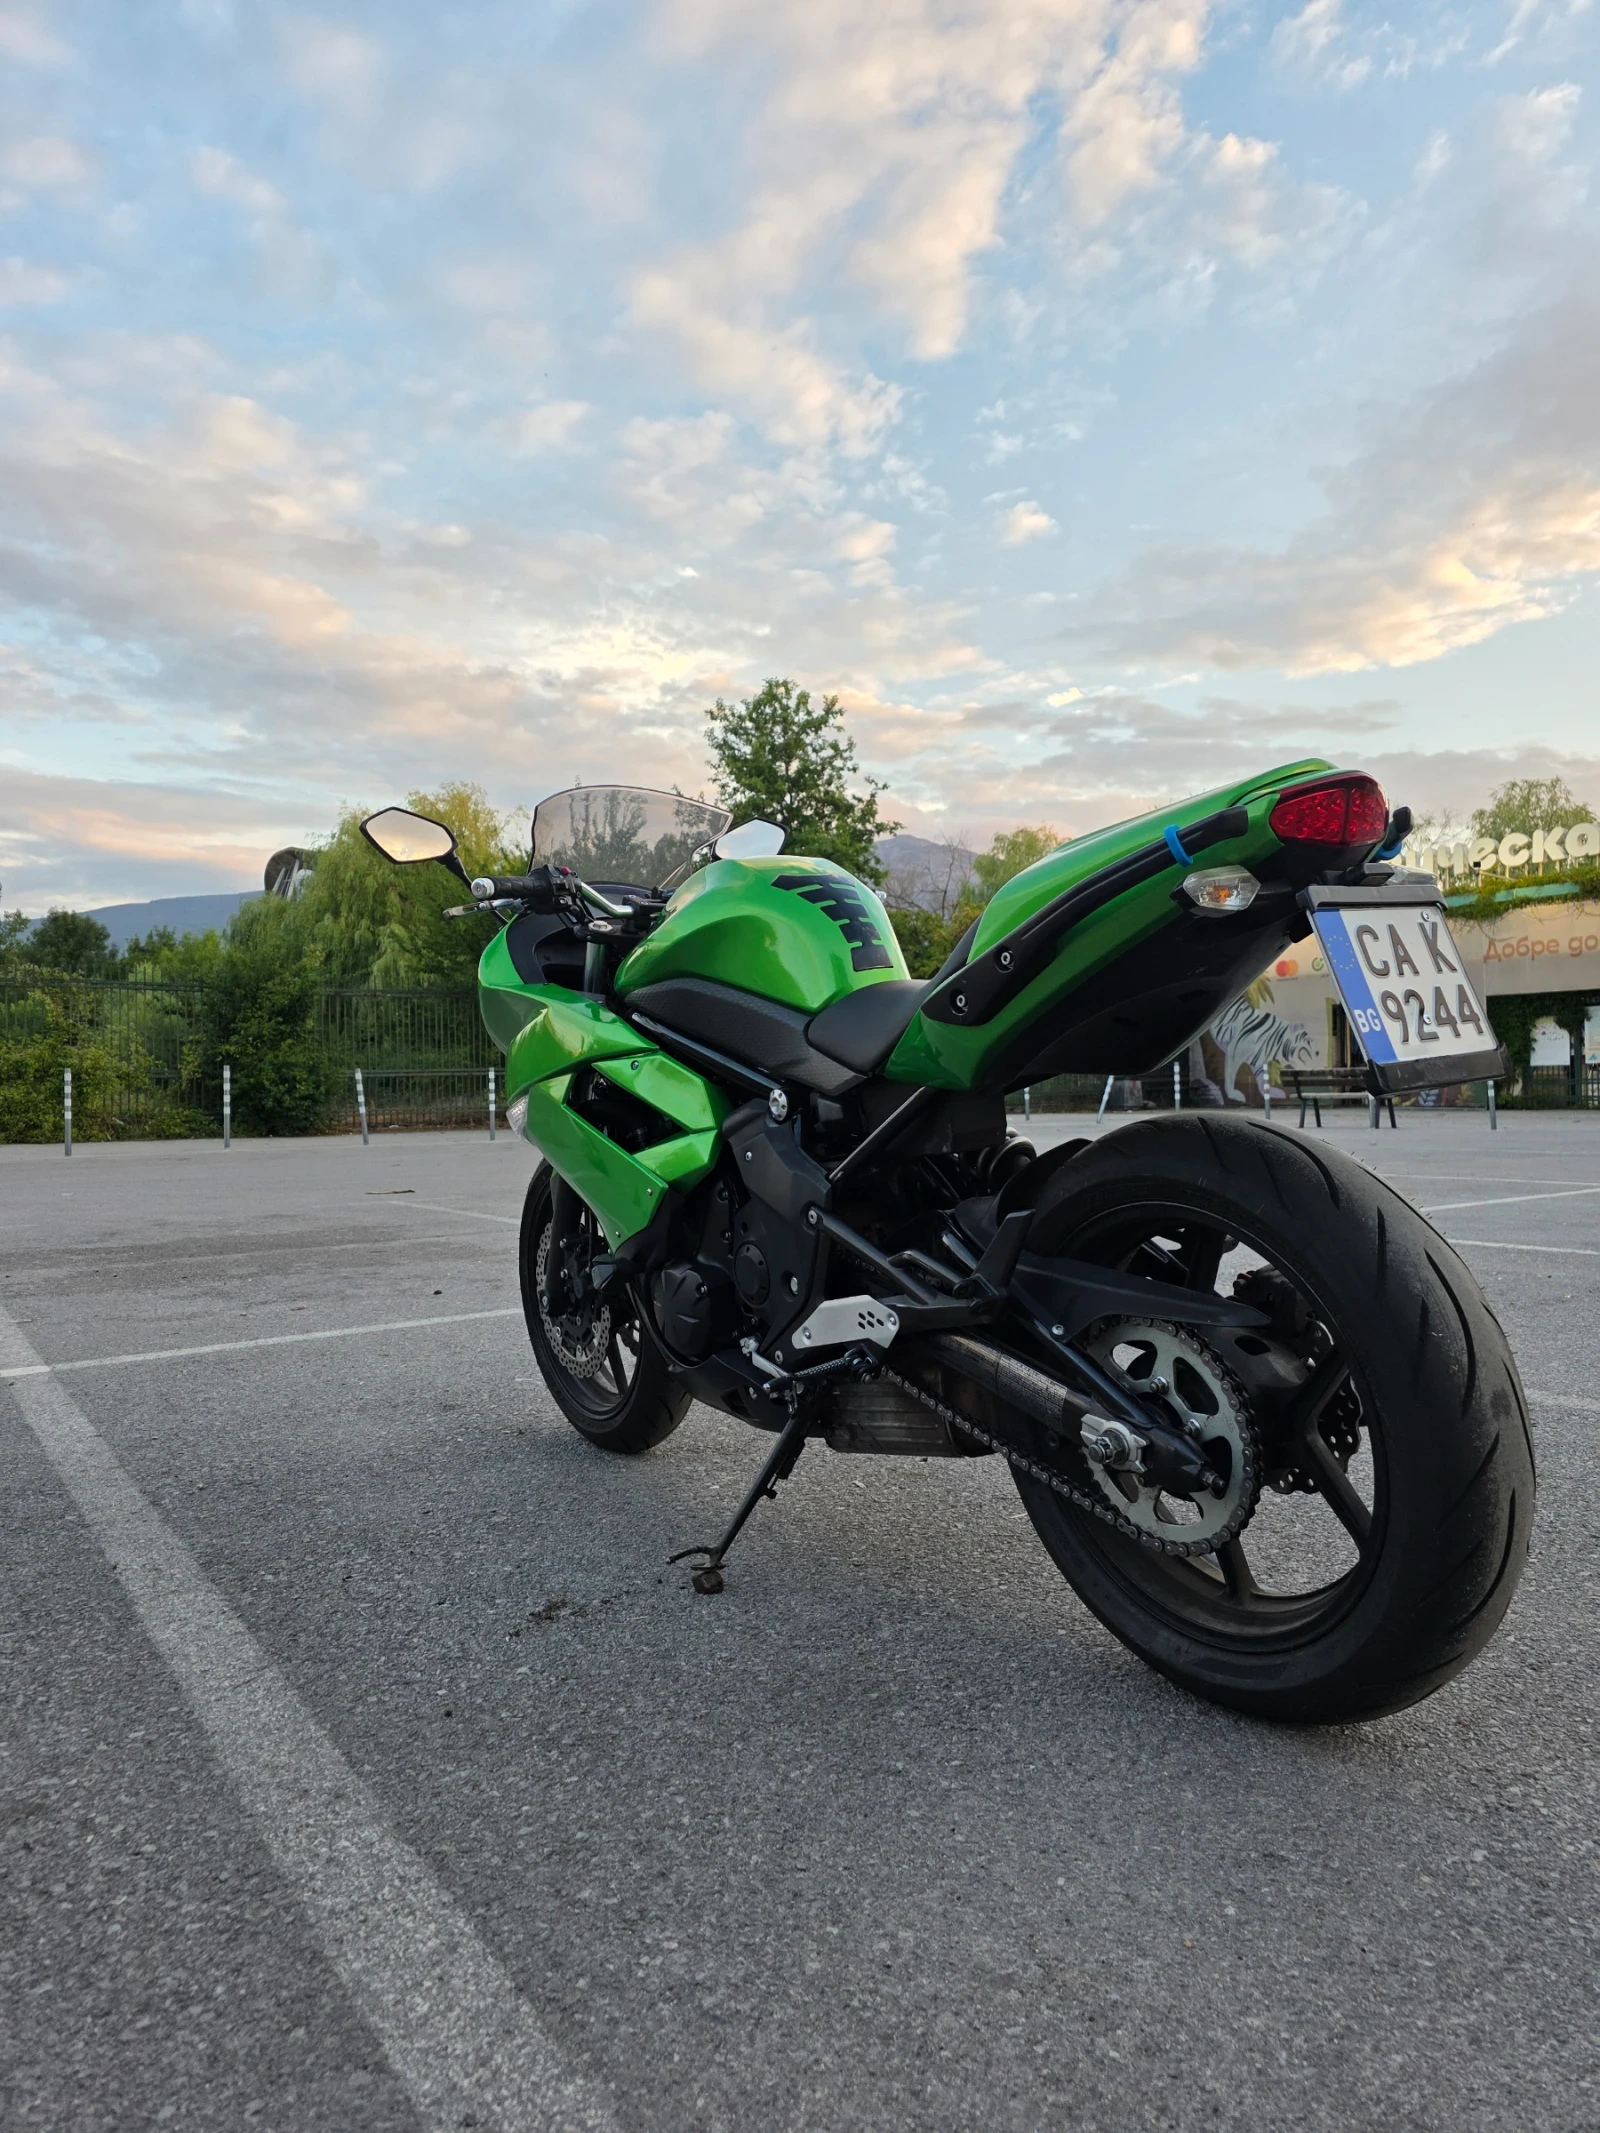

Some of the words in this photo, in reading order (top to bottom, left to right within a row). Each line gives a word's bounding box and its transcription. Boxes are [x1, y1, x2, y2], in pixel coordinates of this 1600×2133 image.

[1390, 822, 1600, 874] ческа
[1355, 923, 1420, 977] CA
[1482, 935, 1560, 964] Добре
[1353, 1008, 1382, 1033] BG
[1379, 983, 1484, 1043] 9244
